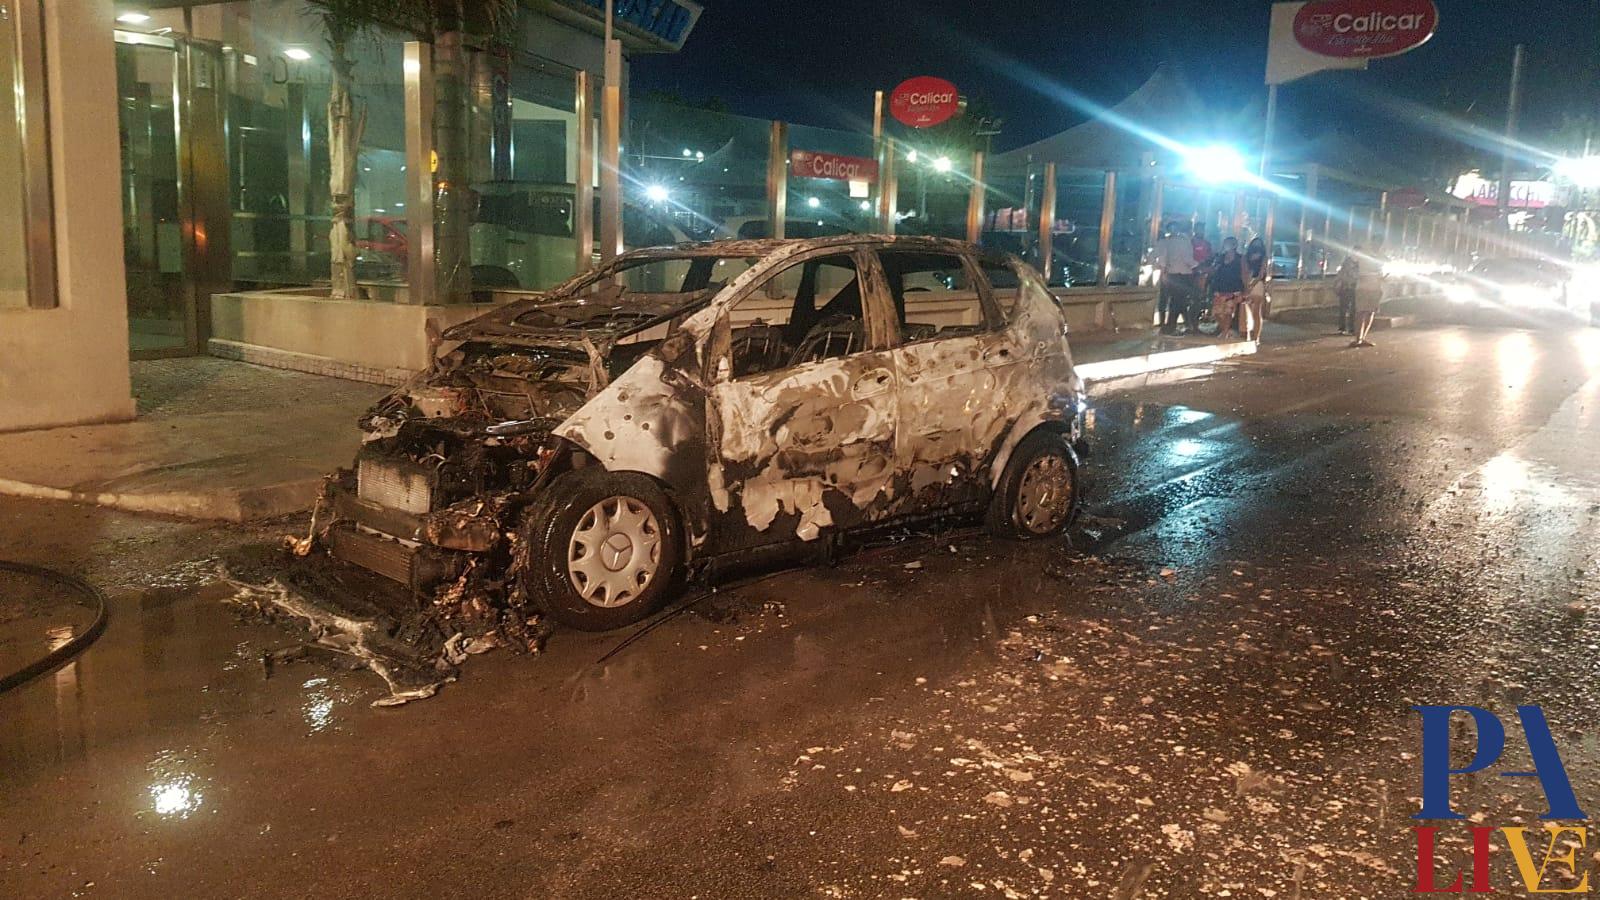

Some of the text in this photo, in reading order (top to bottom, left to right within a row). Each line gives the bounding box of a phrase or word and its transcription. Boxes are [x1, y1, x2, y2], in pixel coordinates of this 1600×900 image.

[1333, 11, 1425, 33] Calicar
[910, 91, 954, 105] Calicar
[812, 154, 859, 177] Calicar
